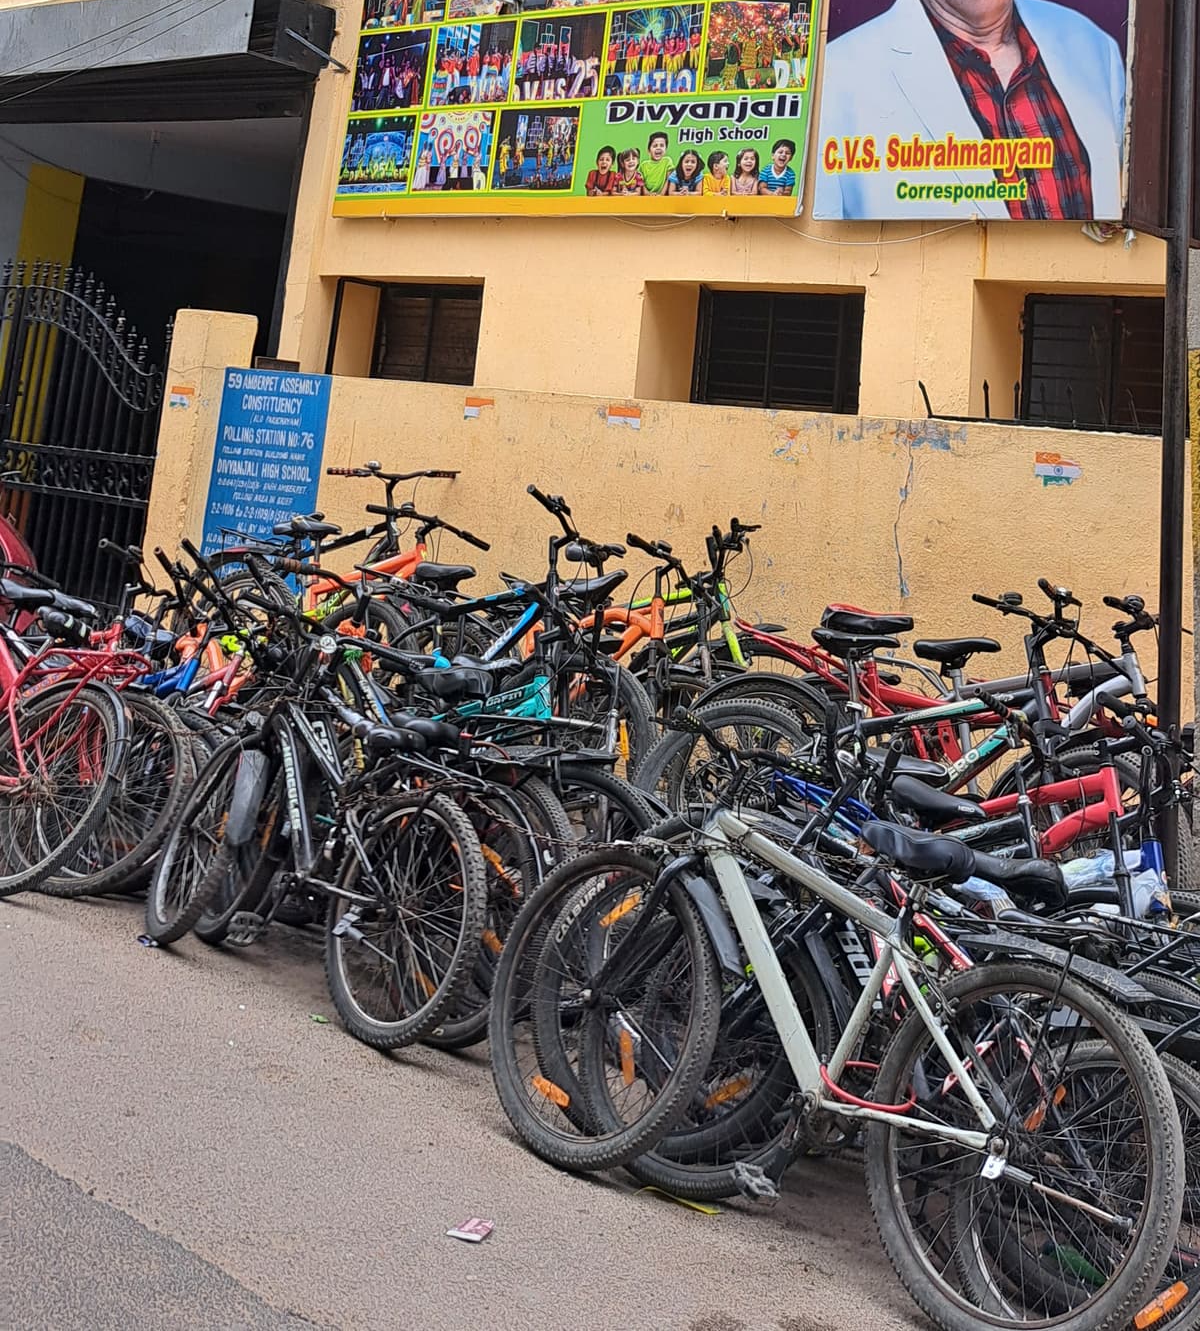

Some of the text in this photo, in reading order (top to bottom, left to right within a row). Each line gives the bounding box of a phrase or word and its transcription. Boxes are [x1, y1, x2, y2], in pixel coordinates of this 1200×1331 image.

[607, 94, 801, 126] Divyanjali
[679, 125, 768, 143] High School
[823, 133, 1053, 177] C.V.S. Subrahmanyam
[896, 180, 1027, 202] Correspondent
[228, 372, 321, 396] 59 AMBERPET ASSEMBLY
[241, 394, 303, 415] CONSTITUENCY
[223, 425, 254, 444] POLLING
[255, 428, 287, 447] STATION
[216, 458, 312, 483] DIVYANJALI HIGH SCHOOL
[555, 878, 606, 943] CALBURN
